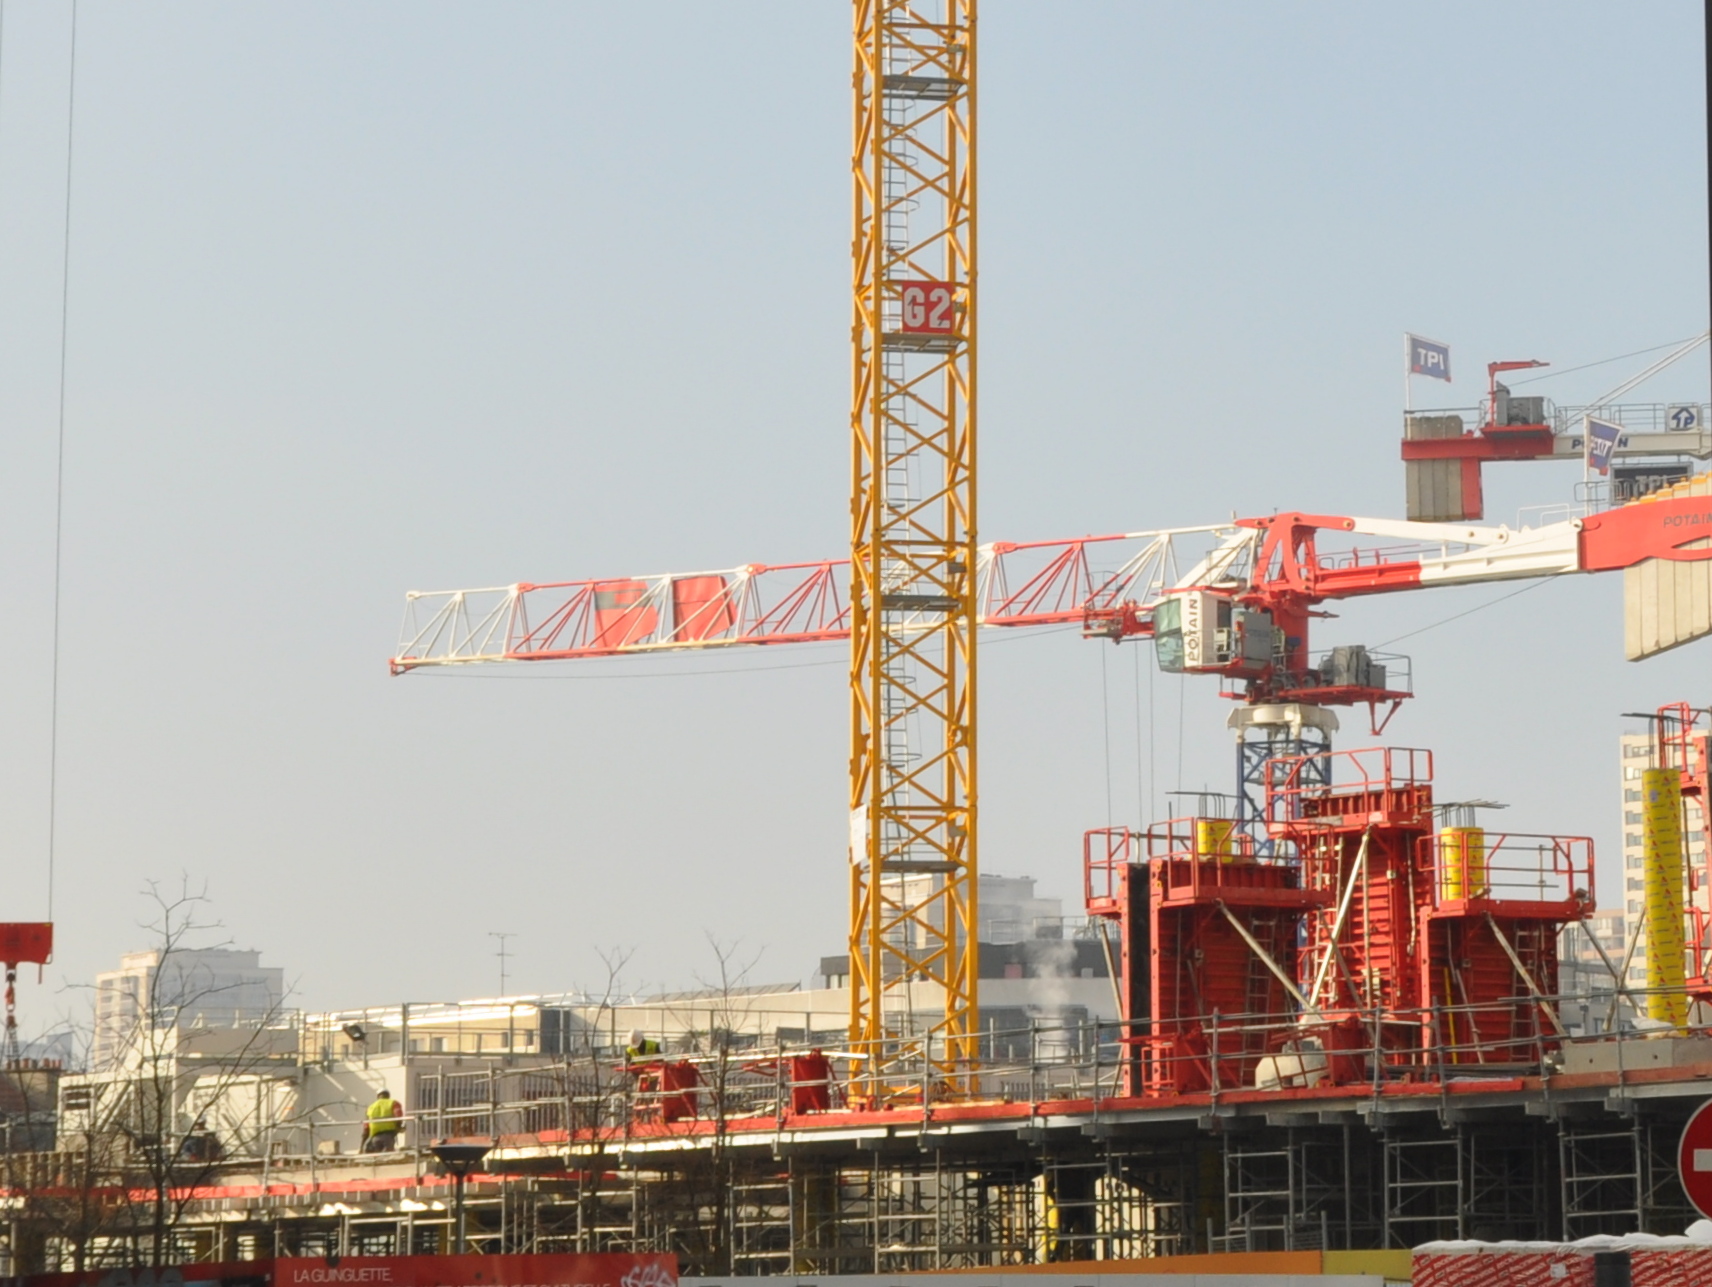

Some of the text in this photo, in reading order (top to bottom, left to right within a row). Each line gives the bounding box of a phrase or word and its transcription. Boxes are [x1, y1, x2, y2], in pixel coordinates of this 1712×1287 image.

[904, 287, 950, 328] G2
[1417, 347, 1444, 370] TPI
[1188, 599, 1200, 661] POTAIN
[294, 1268, 309, 1283] LA
